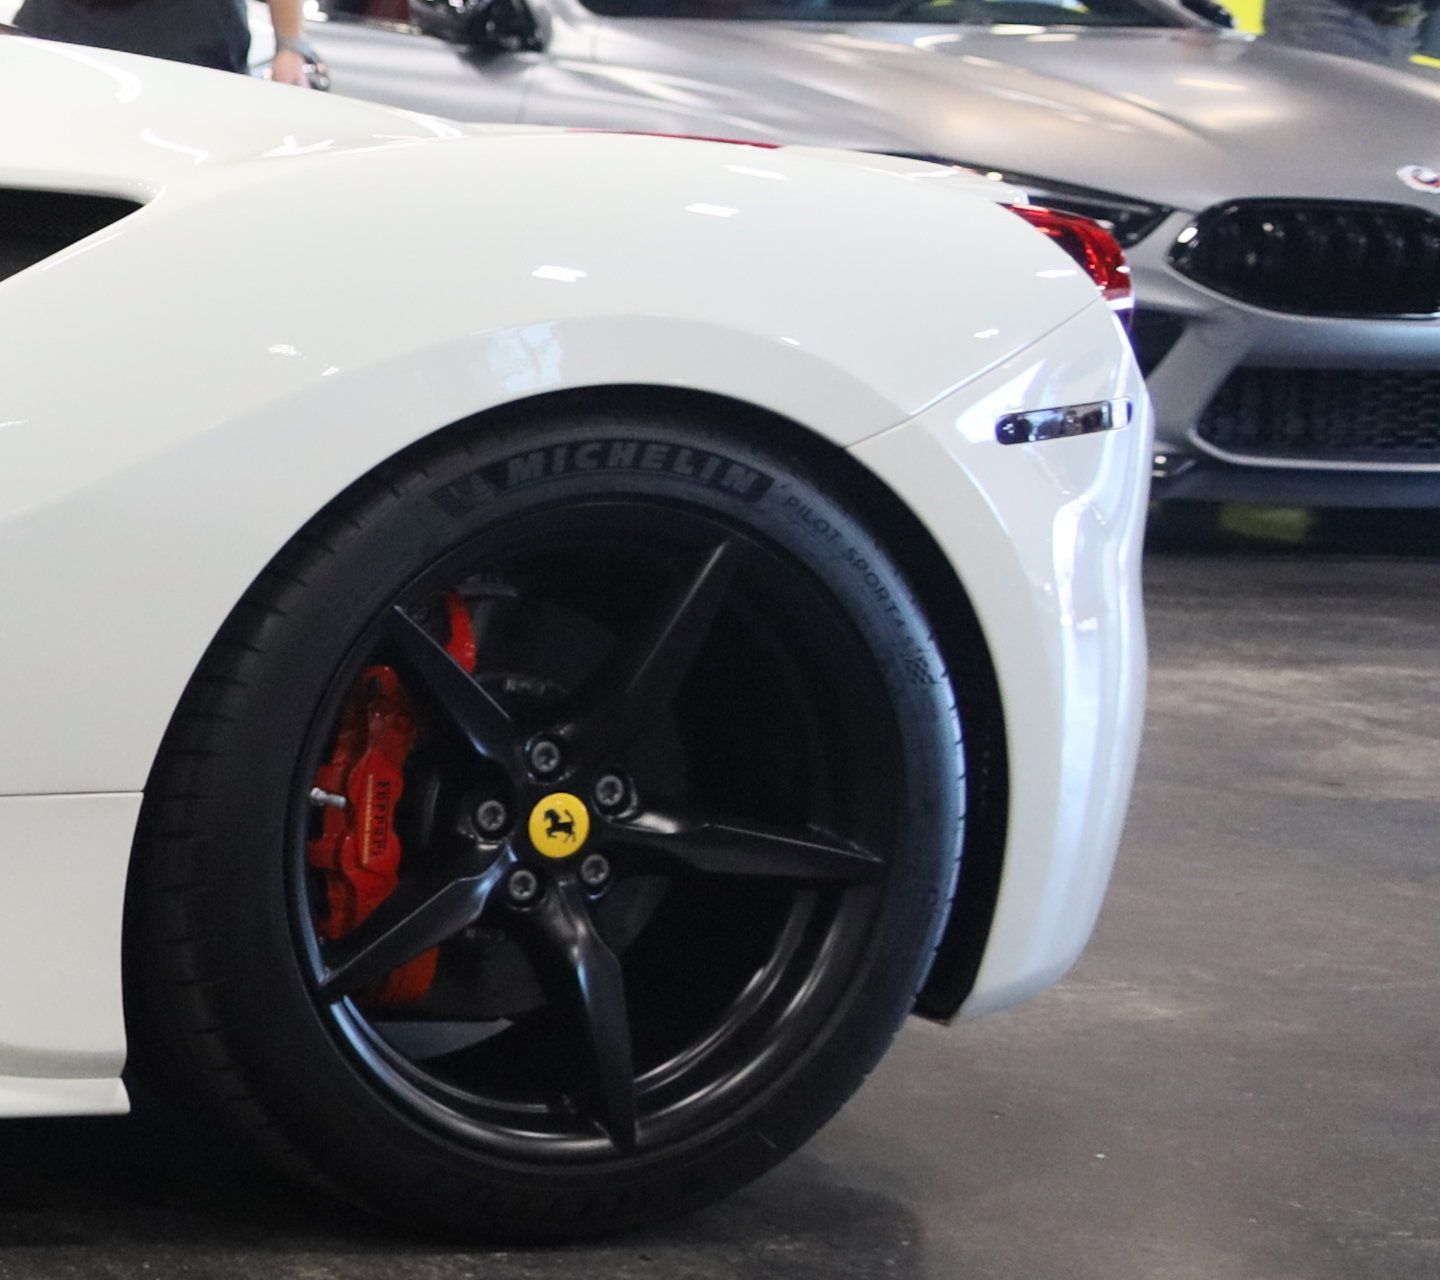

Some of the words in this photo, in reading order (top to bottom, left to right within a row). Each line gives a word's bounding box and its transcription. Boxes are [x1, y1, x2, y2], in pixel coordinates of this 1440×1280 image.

[506, 441, 761, 498] MICHELIN
[782, 494, 843, 544] PILOT
[846, 547, 901, 614] SPORT
